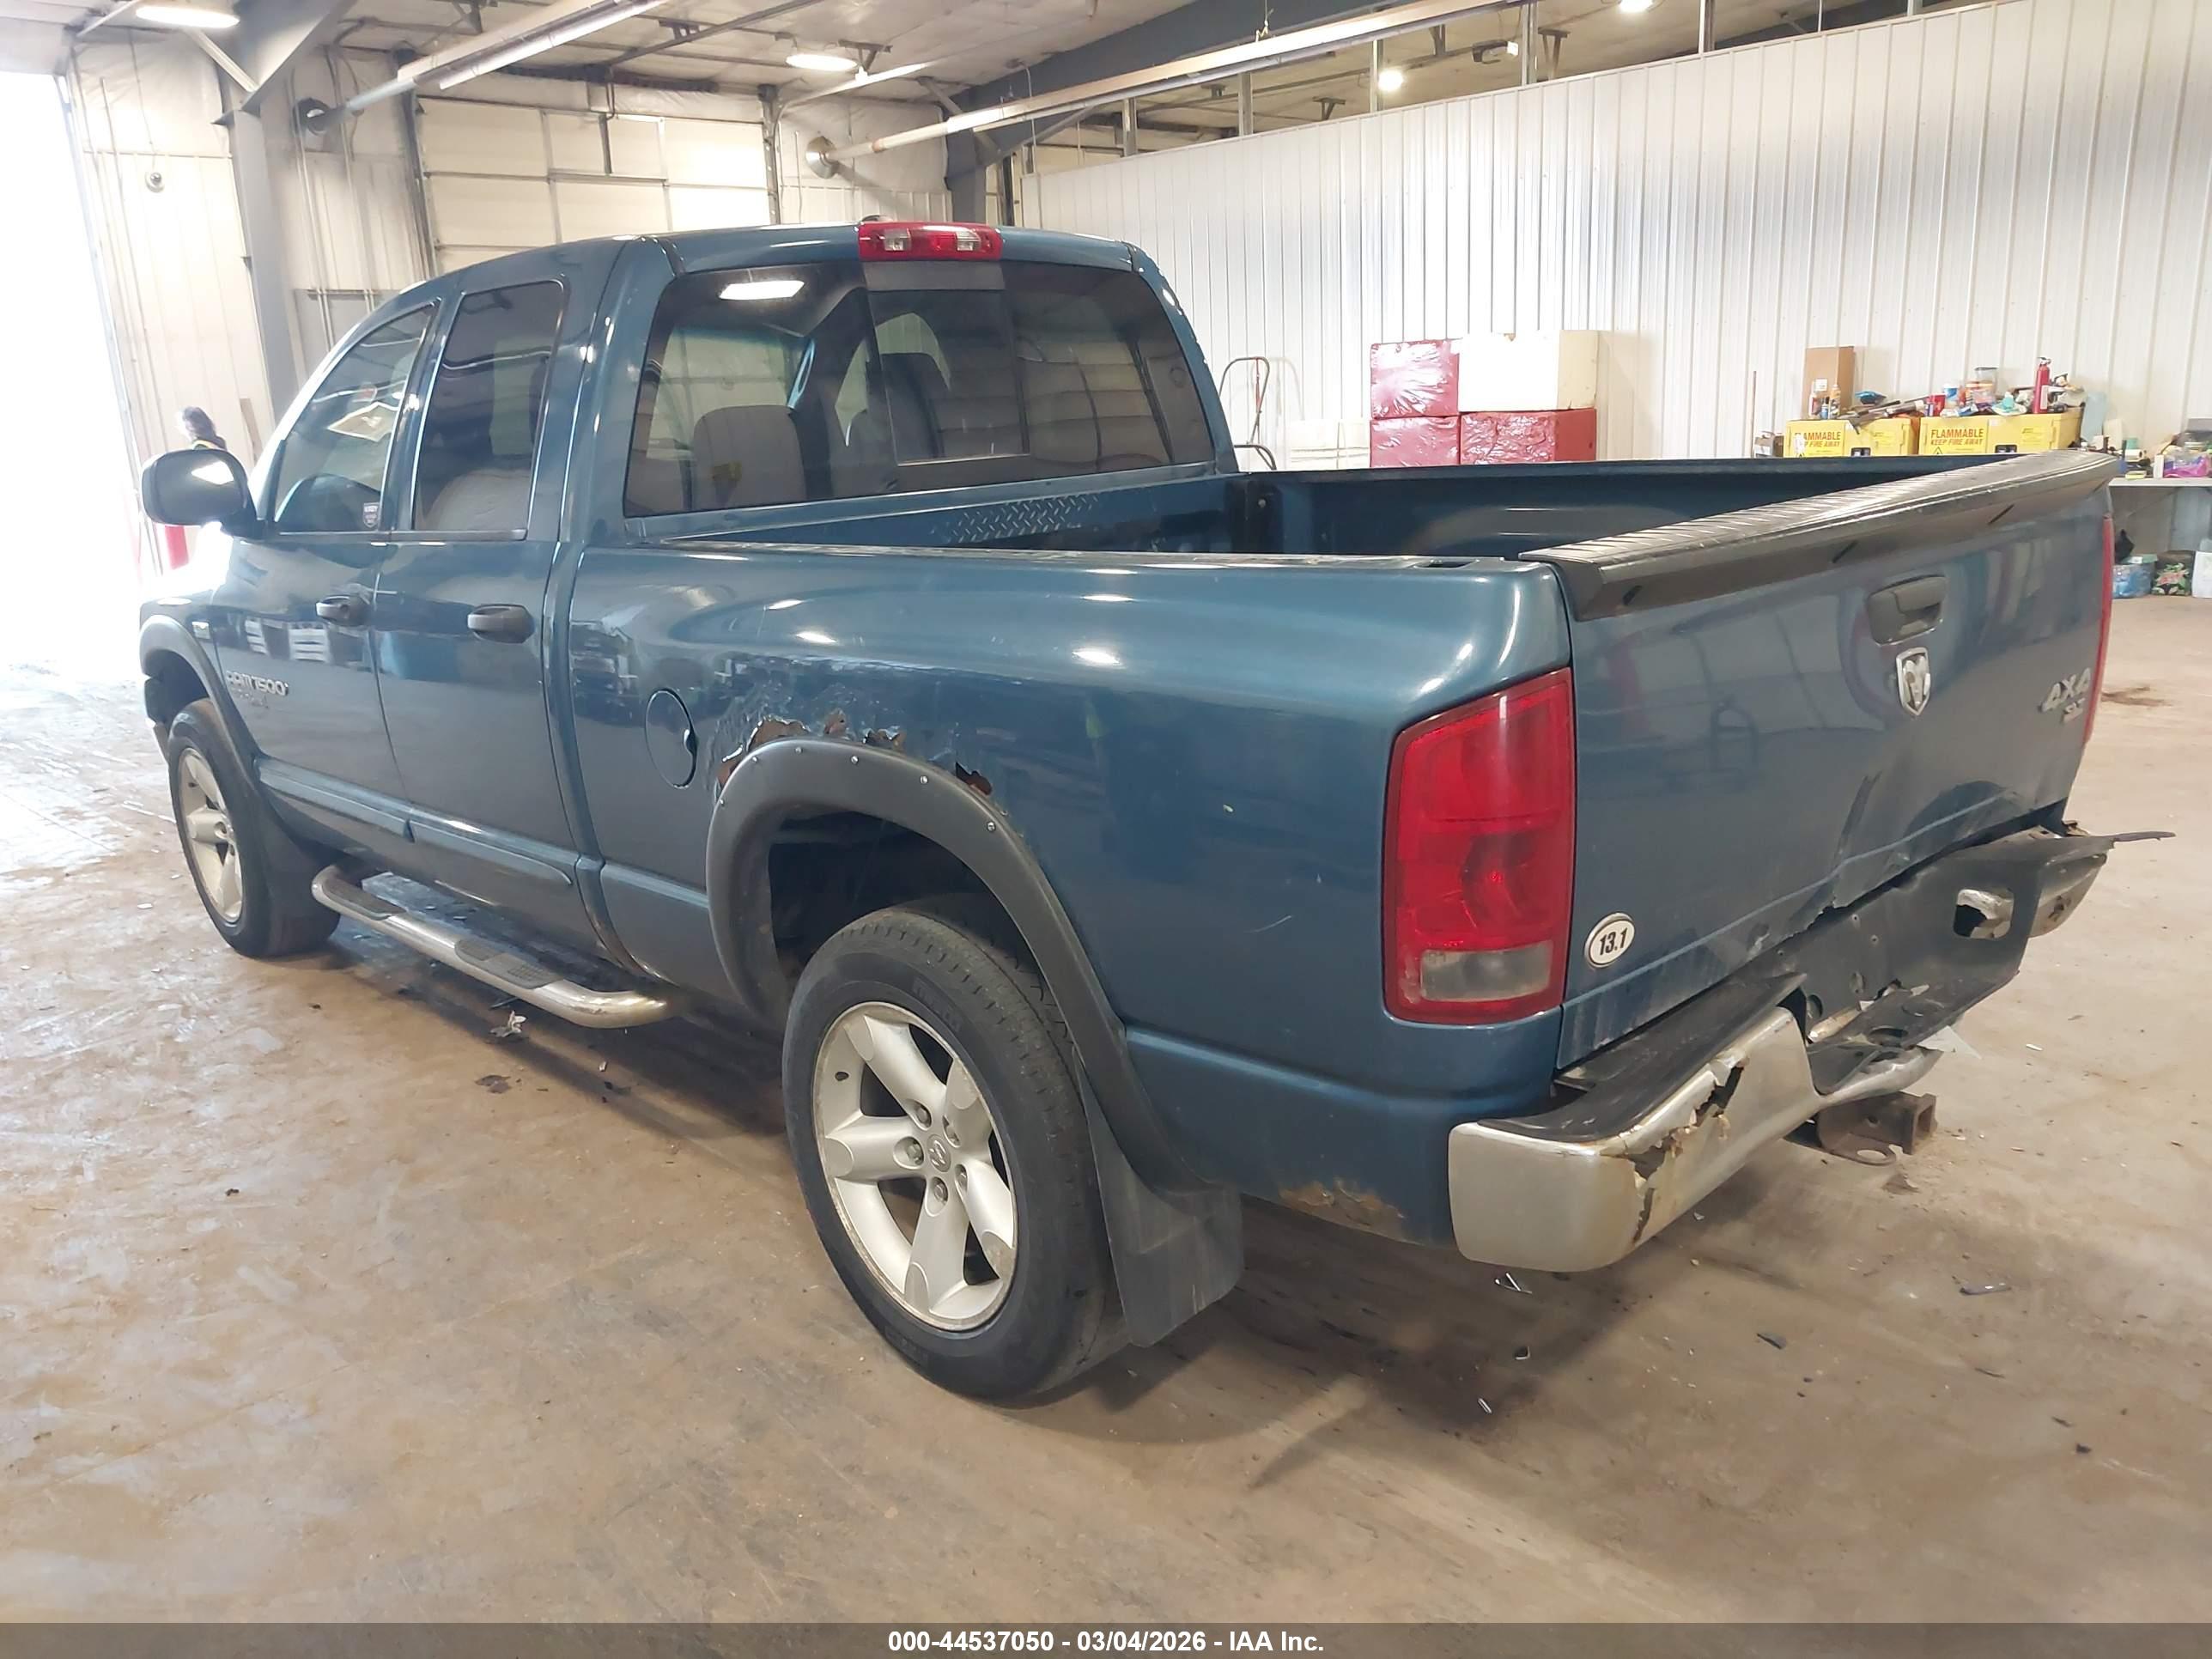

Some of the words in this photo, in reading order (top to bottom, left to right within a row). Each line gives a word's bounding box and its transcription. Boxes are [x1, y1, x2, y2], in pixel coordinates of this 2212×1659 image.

[1795, 431, 1841, 441] AMMABLE
[1931, 428, 1984, 438] FLAMMABLE
[2038, 667, 2091, 712] 4X4
[1599, 928, 1628, 956] 13.1
